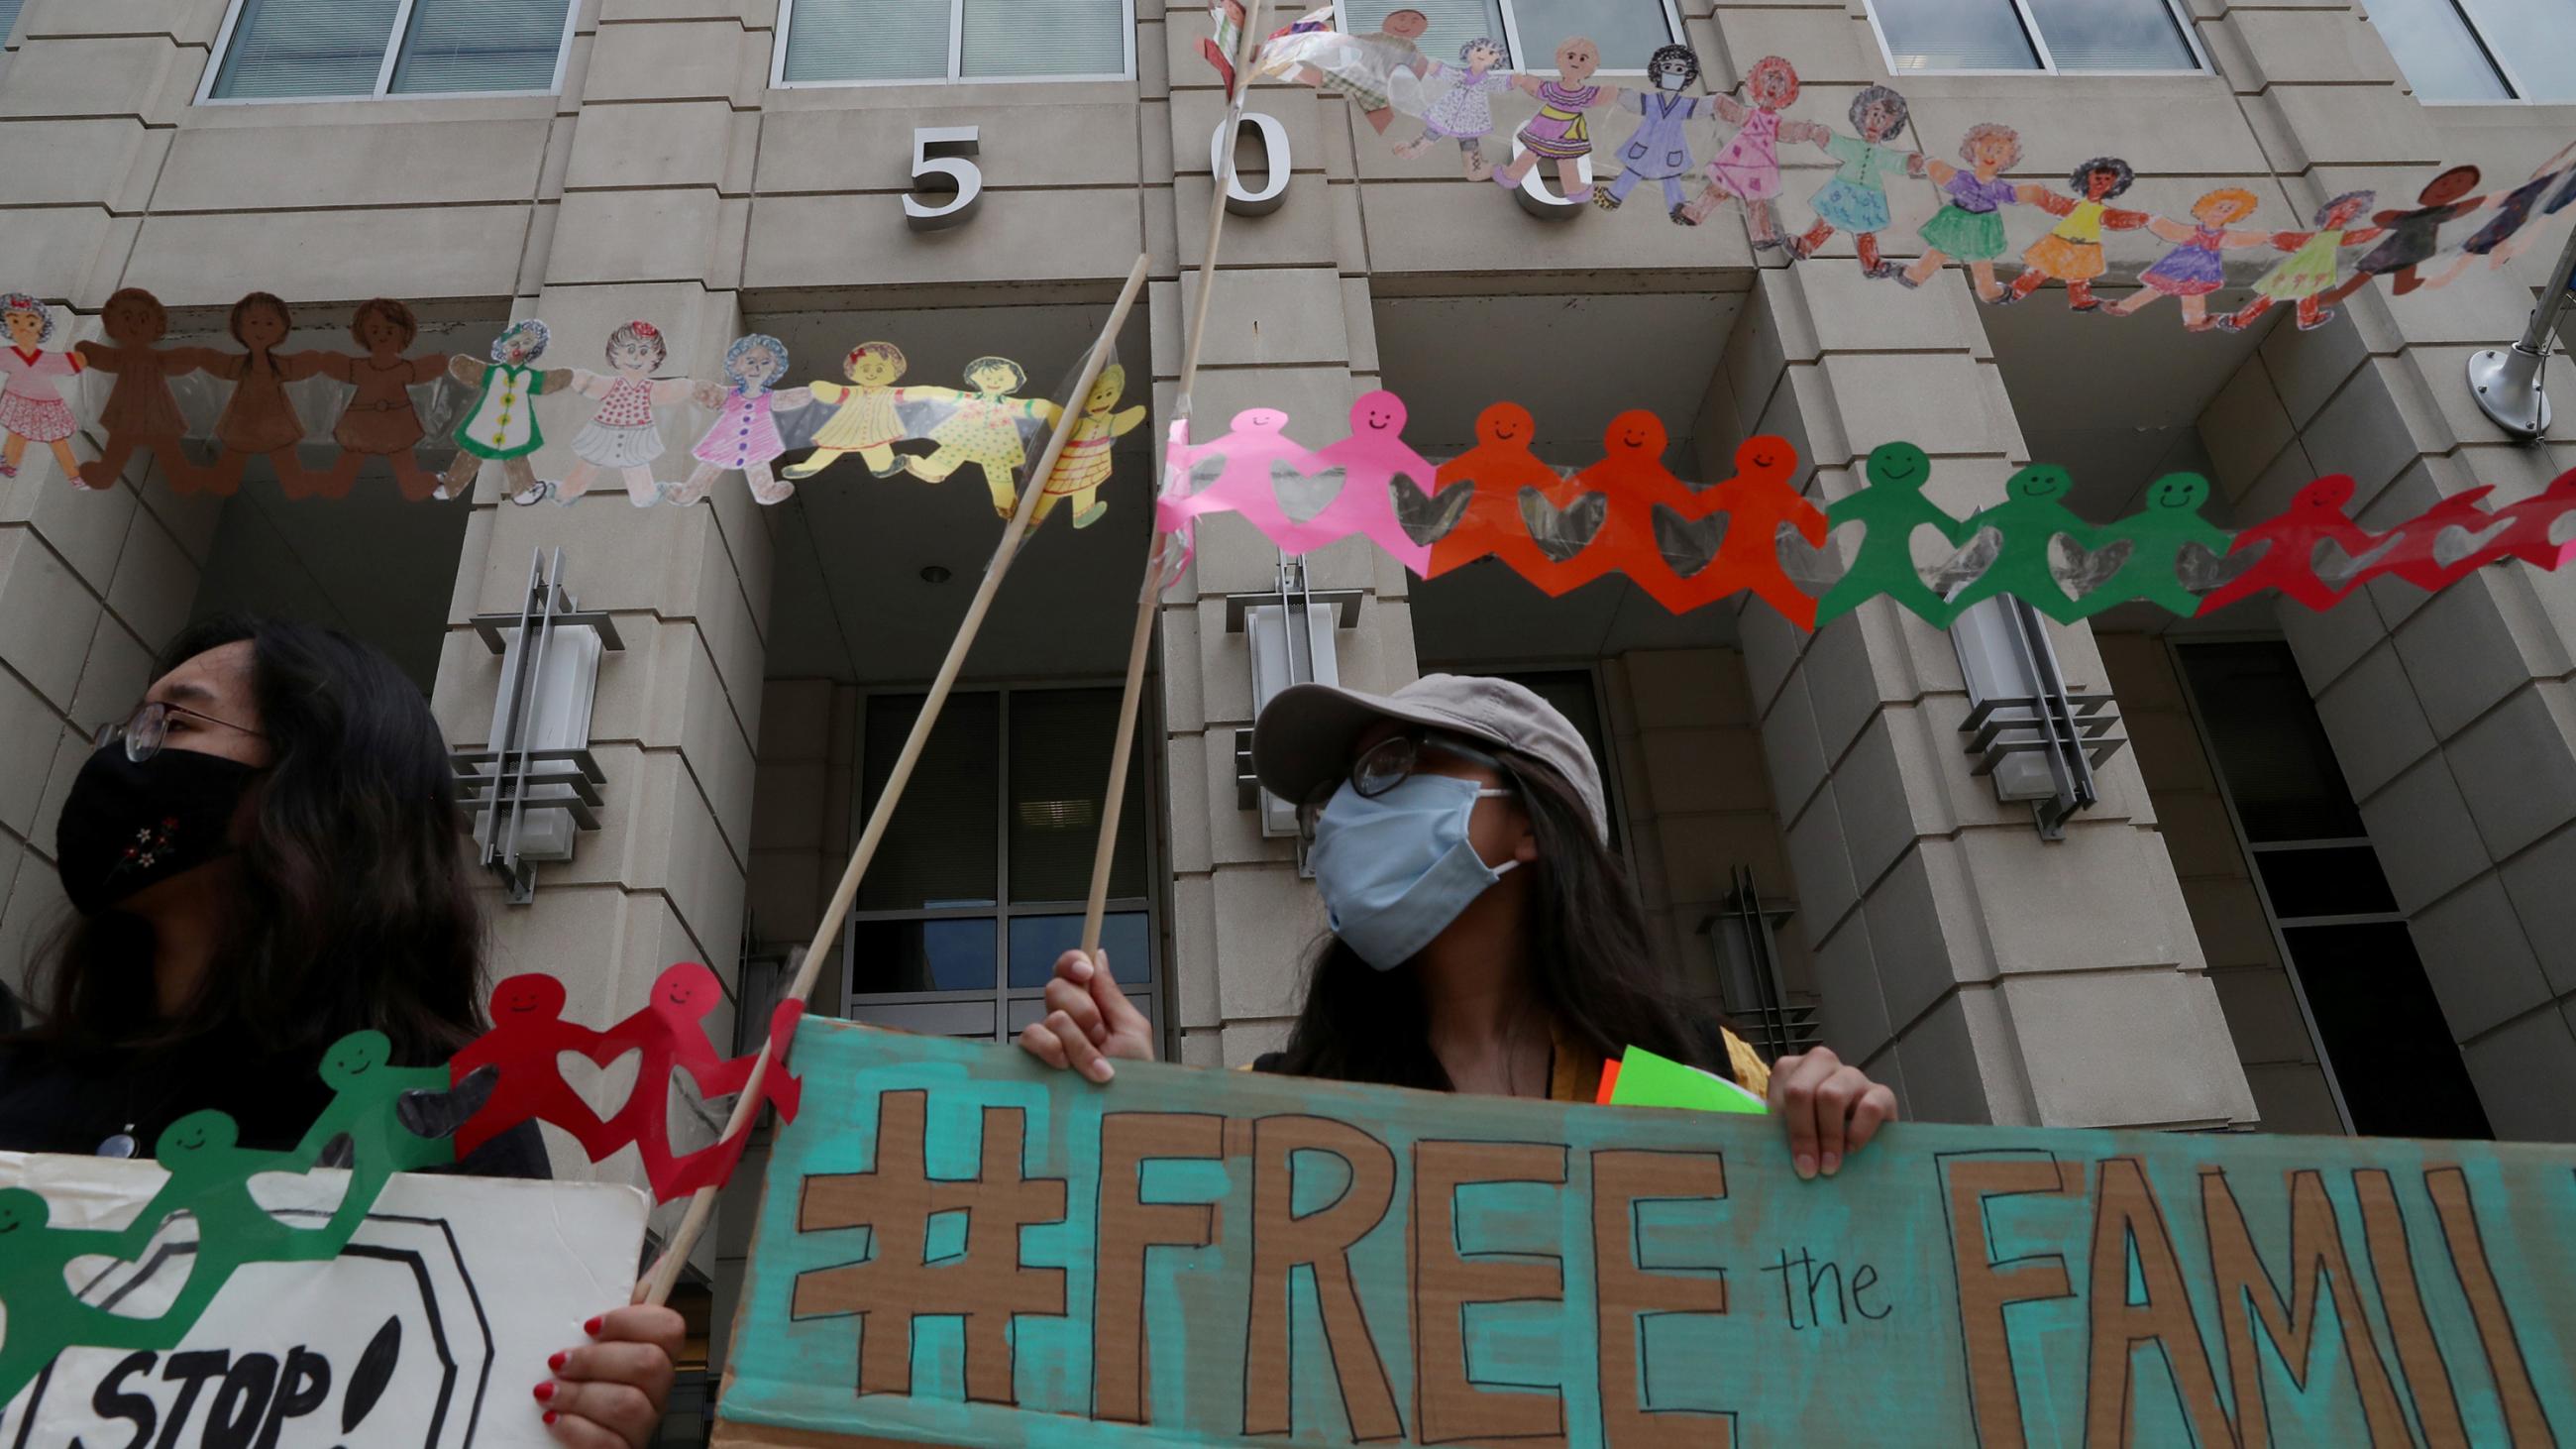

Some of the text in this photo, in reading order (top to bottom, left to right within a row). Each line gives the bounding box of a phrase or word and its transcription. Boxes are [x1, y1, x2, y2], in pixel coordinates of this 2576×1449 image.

[67, 1314, 402, 1449] STOP!
[791, 1088, 1739, 1449] #FREE
[1761, 1247, 1892, 1331] the
